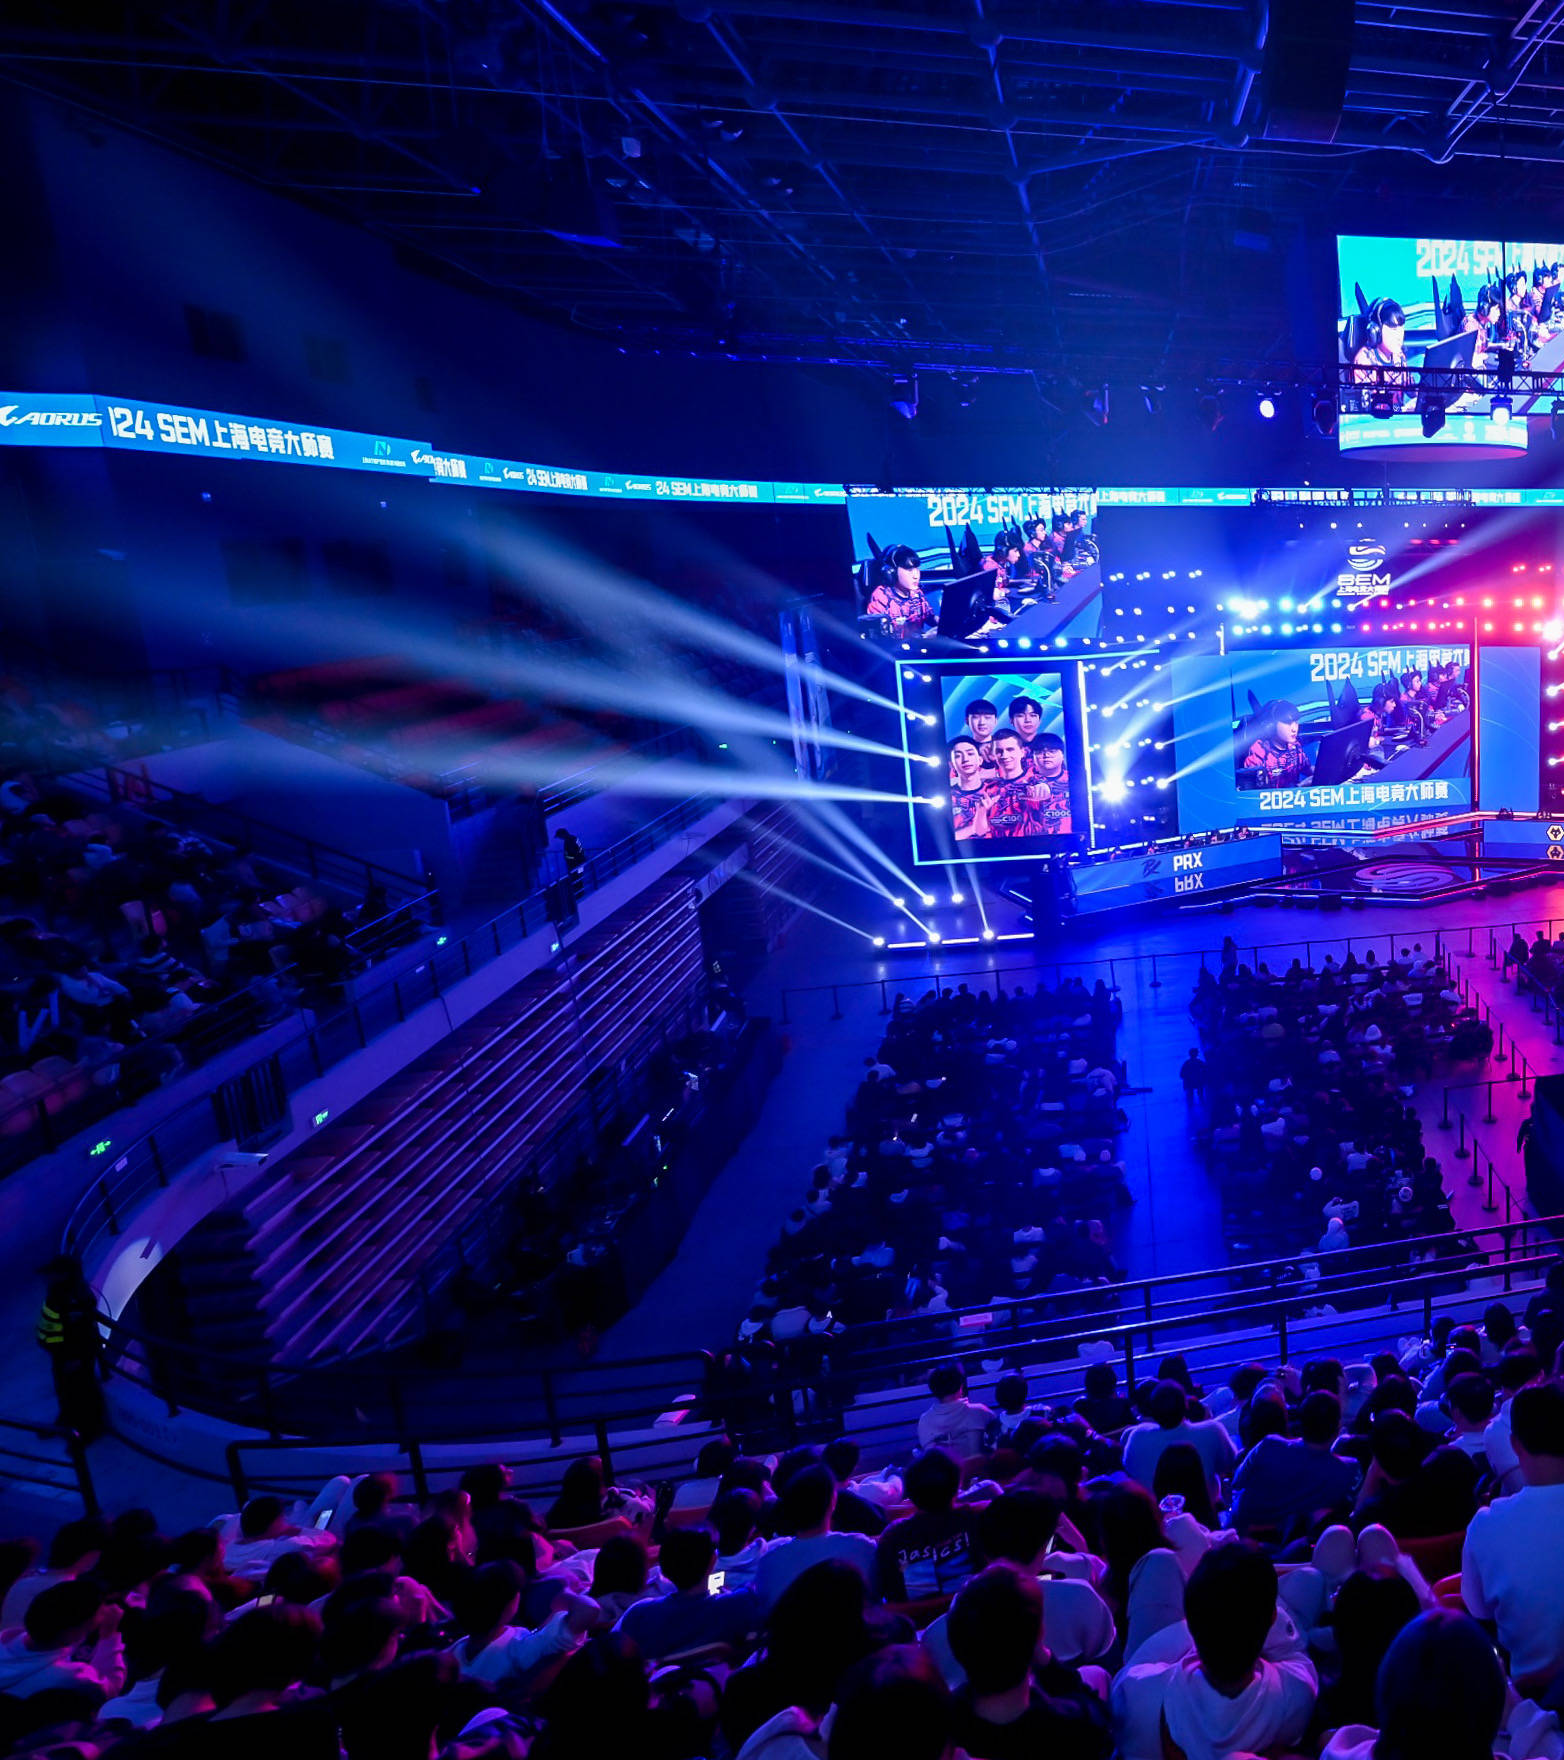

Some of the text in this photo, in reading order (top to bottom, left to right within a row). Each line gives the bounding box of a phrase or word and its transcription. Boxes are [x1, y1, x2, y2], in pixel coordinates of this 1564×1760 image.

[14, 411, 104, 427] AORUS
[107, 405, 155, 441] 24
[927, 494, 983, 528] 2024
[1310, 652, 1364, 683] 2024
[1259, 781, 1449, 811] 2024 SEM上海电竞大师赛
[1173, 851, 1203, 872] PRX
